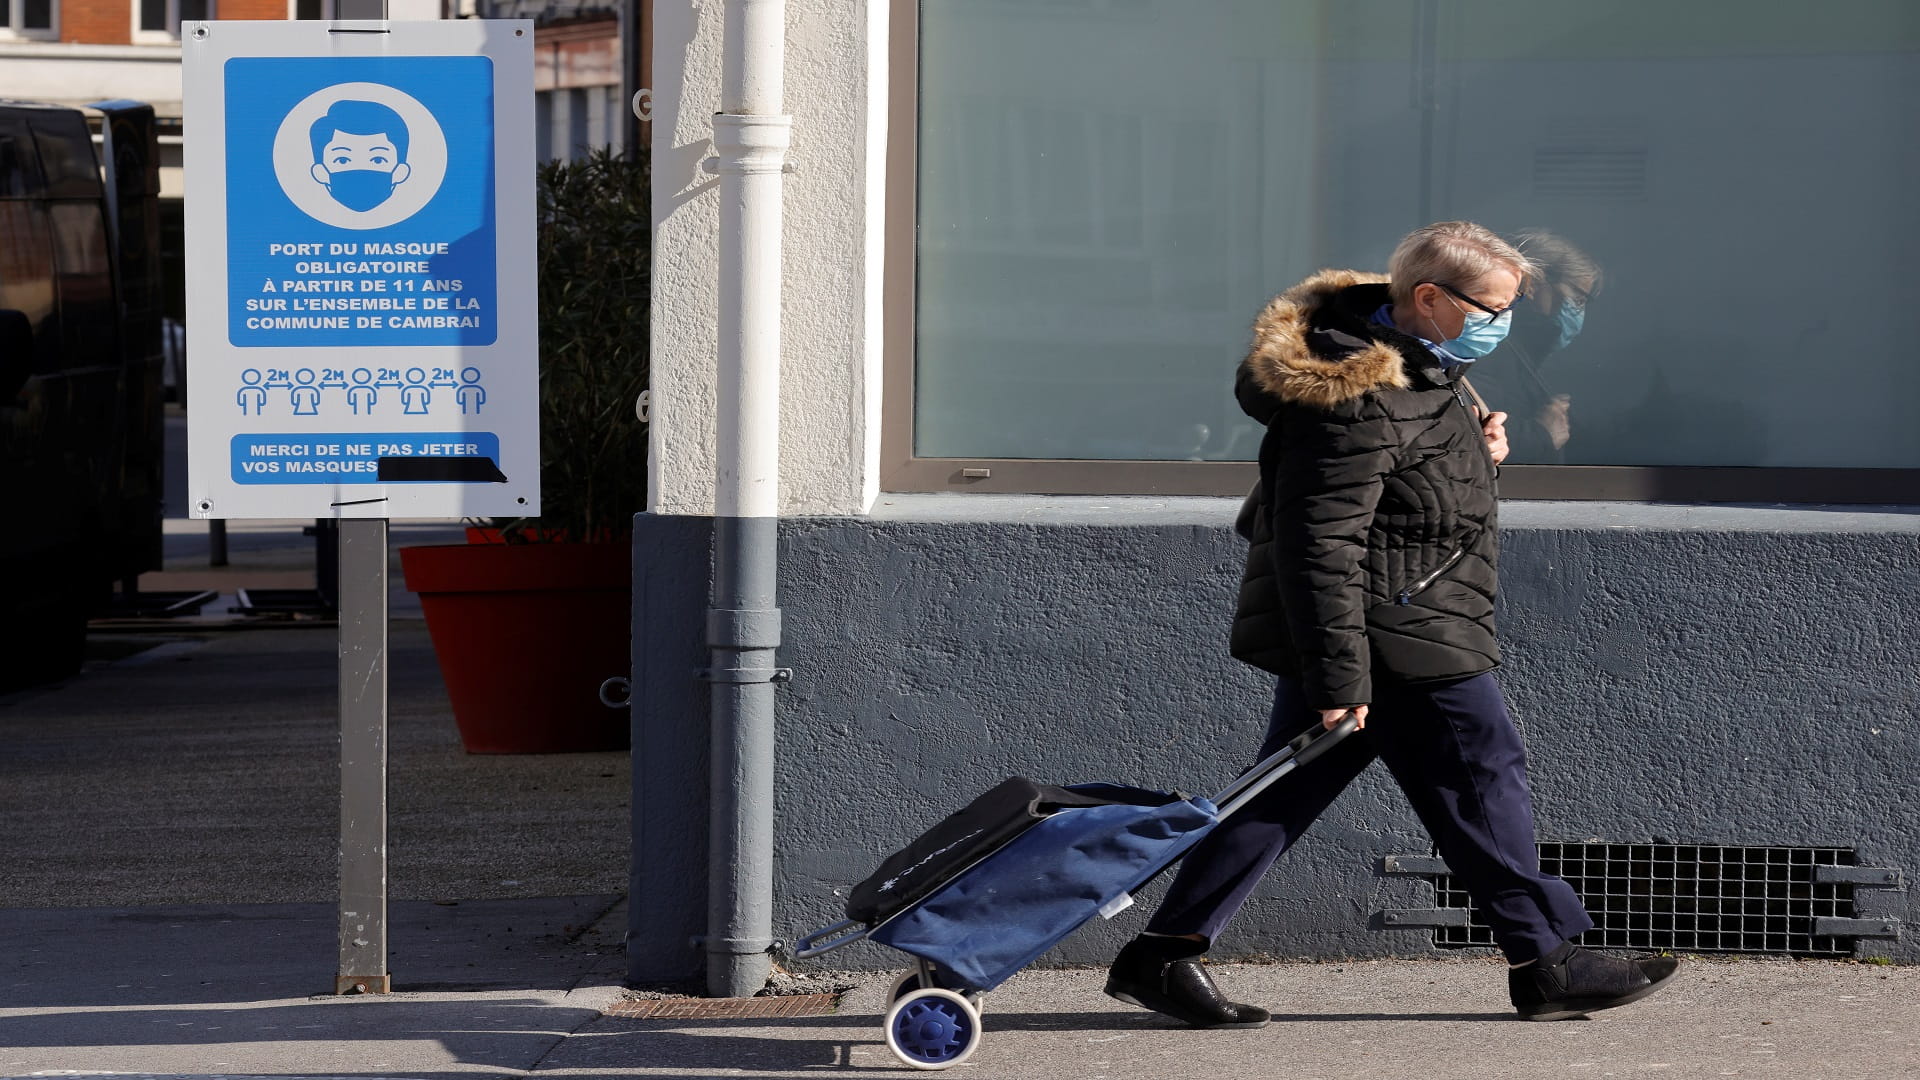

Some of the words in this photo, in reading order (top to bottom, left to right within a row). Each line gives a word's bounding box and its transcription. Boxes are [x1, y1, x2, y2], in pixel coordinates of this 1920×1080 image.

[271, 244, 323, 255] PORT
[330, 244, 357, 255] DU
[365, 243, 448, 255] MASQUE
[296, 262, 428, 273] OBLIGATOIRE
[263, 278, 276, 292] À
[283, 281, 354, 292] PARTIR
[361, 280, 386, 291] DE
[394, 280, 413, 291] 11
[422, 280, 462, 291] ANS
[247, 299, 286, 310] SUR
[424, 298, 448, 309] DE
[456, 298, 480, 309] LA
[247, 317, 349, 329] COMMUNE
[357, 317, 382, 328] DE
[389, 317, 479, 328] CAMBRAI
[268, 369, 289, 381] 2M
[323, 368, 344, 381] 2M
[378, 368, 399, 380] 2M
[432, 368, 454, 380] 2M
[251, 445, 308, 456] MERCI
[316, 445, 339, 455] DE
[347, 445, 371, 455] NE
[378, 444, 412, 455] PAS
[419, 444, 478, 455] JETER
[242, 462, 279, 472] VOS
[286, 461, 377, 472] MASQUES
